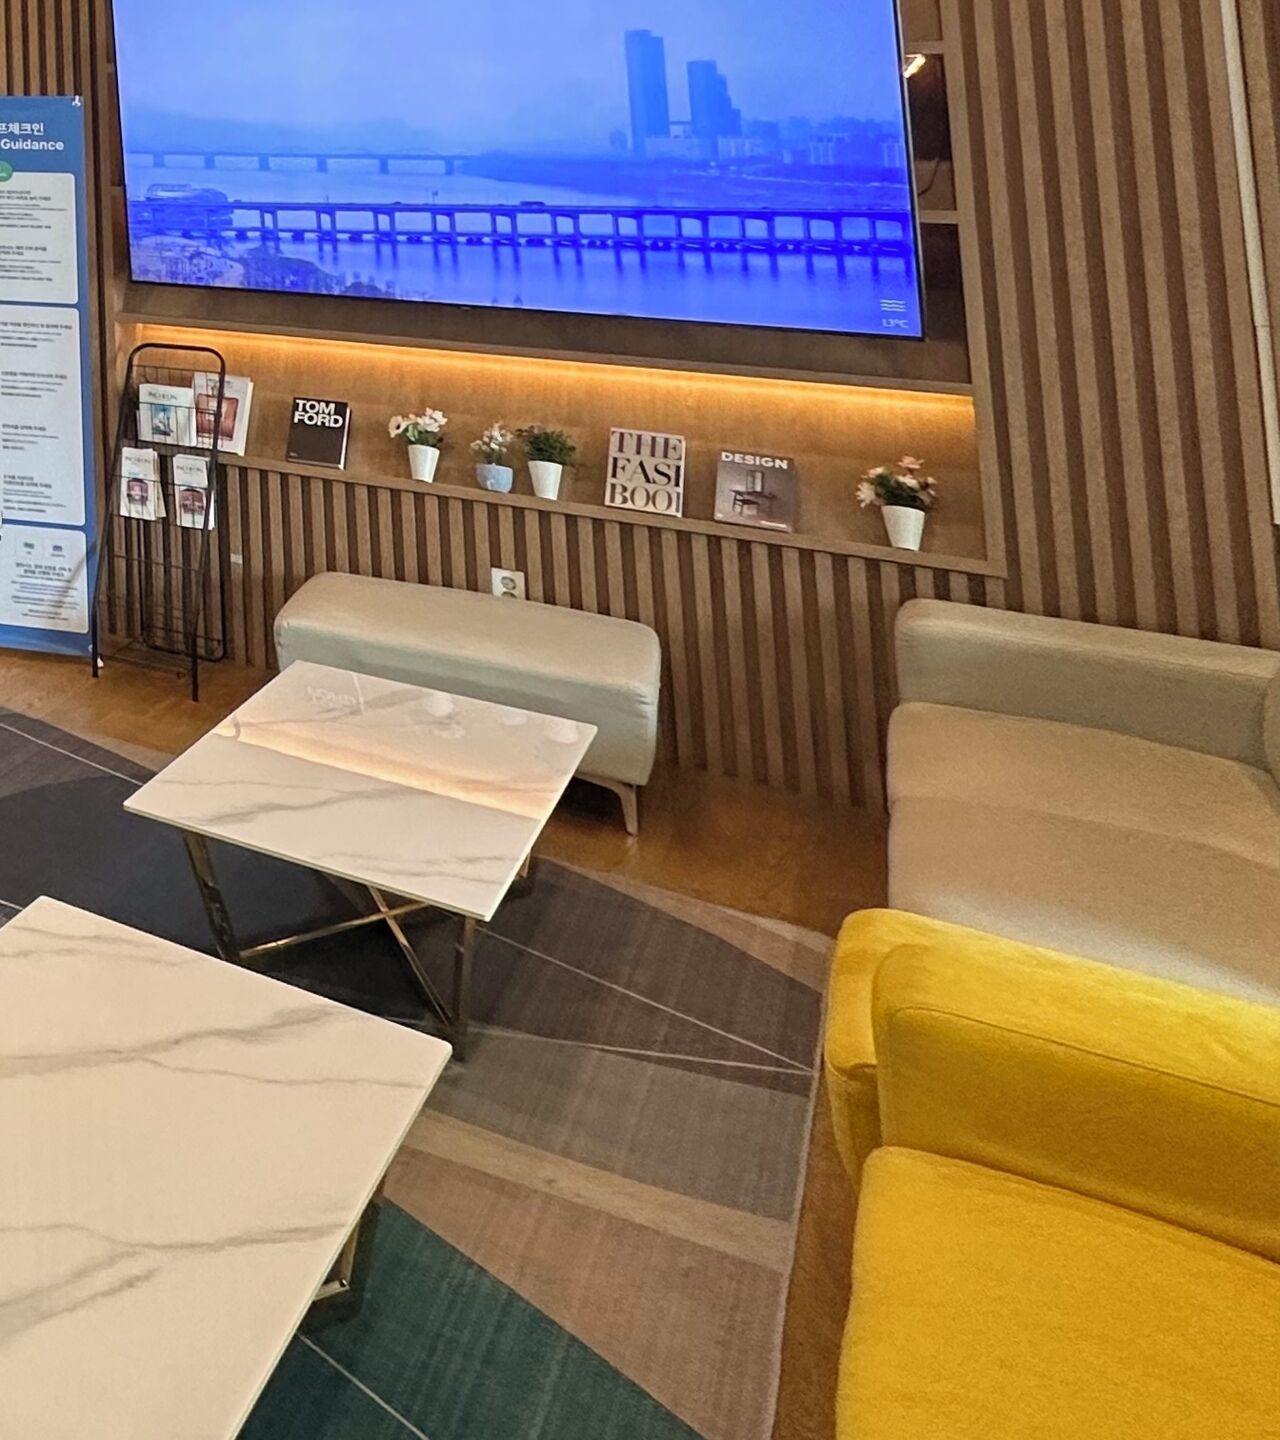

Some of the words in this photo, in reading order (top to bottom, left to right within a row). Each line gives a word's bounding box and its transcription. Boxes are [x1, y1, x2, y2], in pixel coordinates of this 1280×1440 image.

[0, 140, 65, 151] Guidance
[296, 399, 336, 415] TOM
[293, 411, 343, 428] FORD
[611, 430, 682, 461] THE
[721, 450, 789, 470] DESIGN
